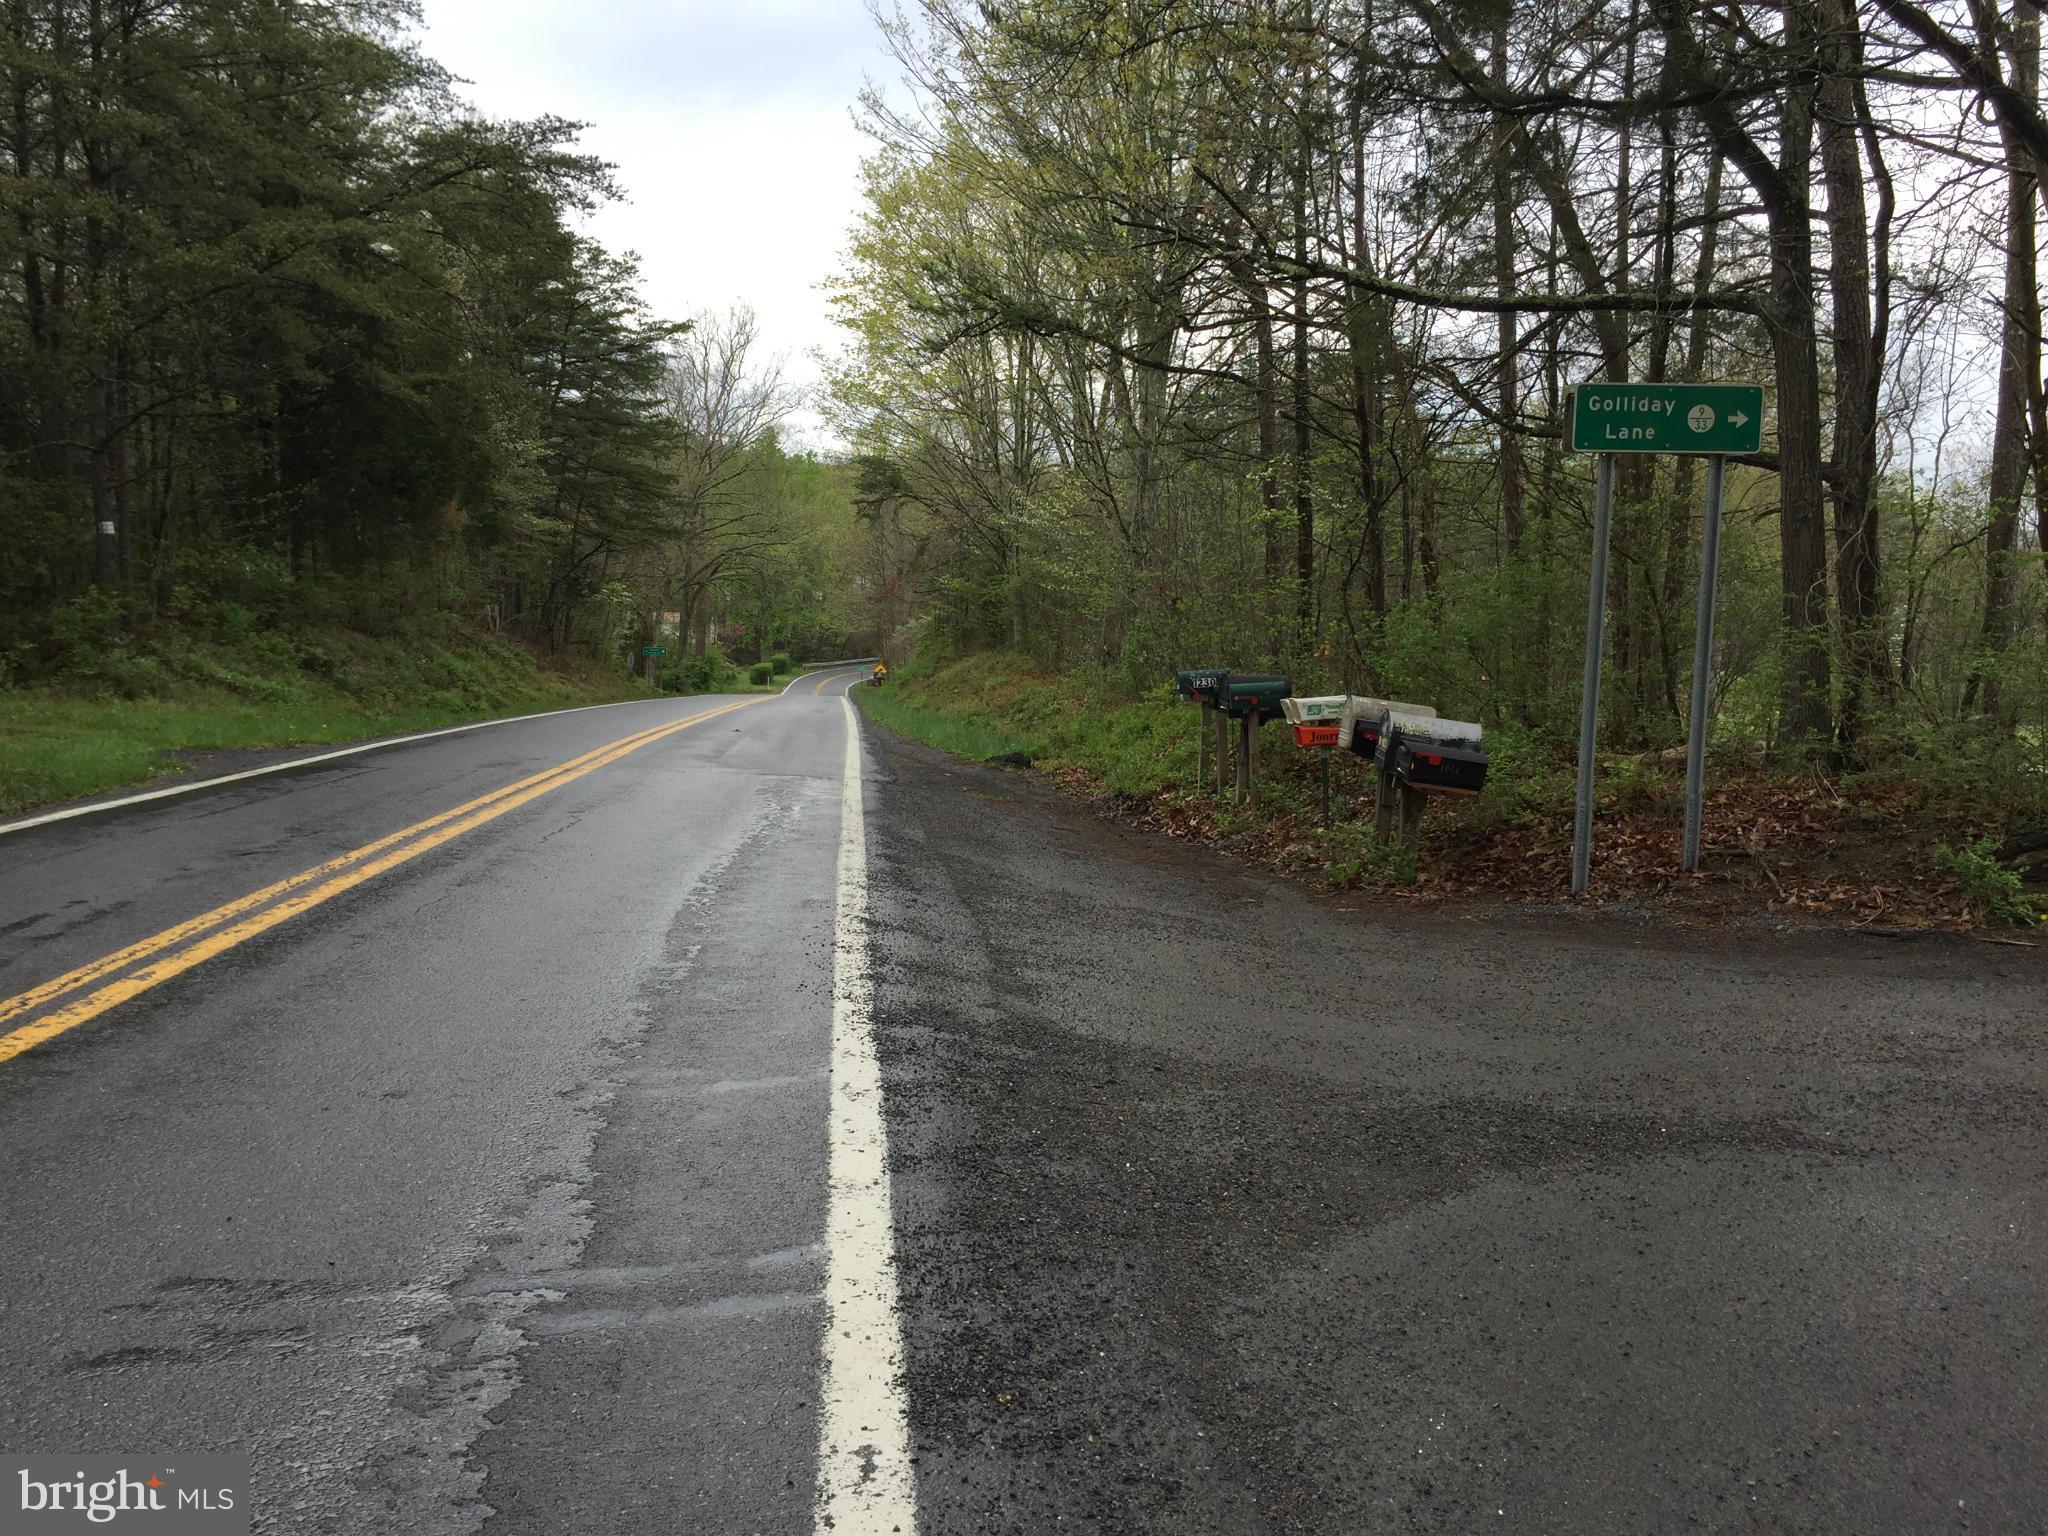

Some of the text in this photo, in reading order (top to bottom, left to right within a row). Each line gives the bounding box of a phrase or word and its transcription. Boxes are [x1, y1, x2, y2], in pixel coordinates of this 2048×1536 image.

[1588, 395, 1676, 416] Golliday
[1698, 407, 1705, 417] 9
[1695, 420, 1708, 431] 33
[1605, 424, 1656, 440] Lane
[1192, 677, 1217, 689] 1230
